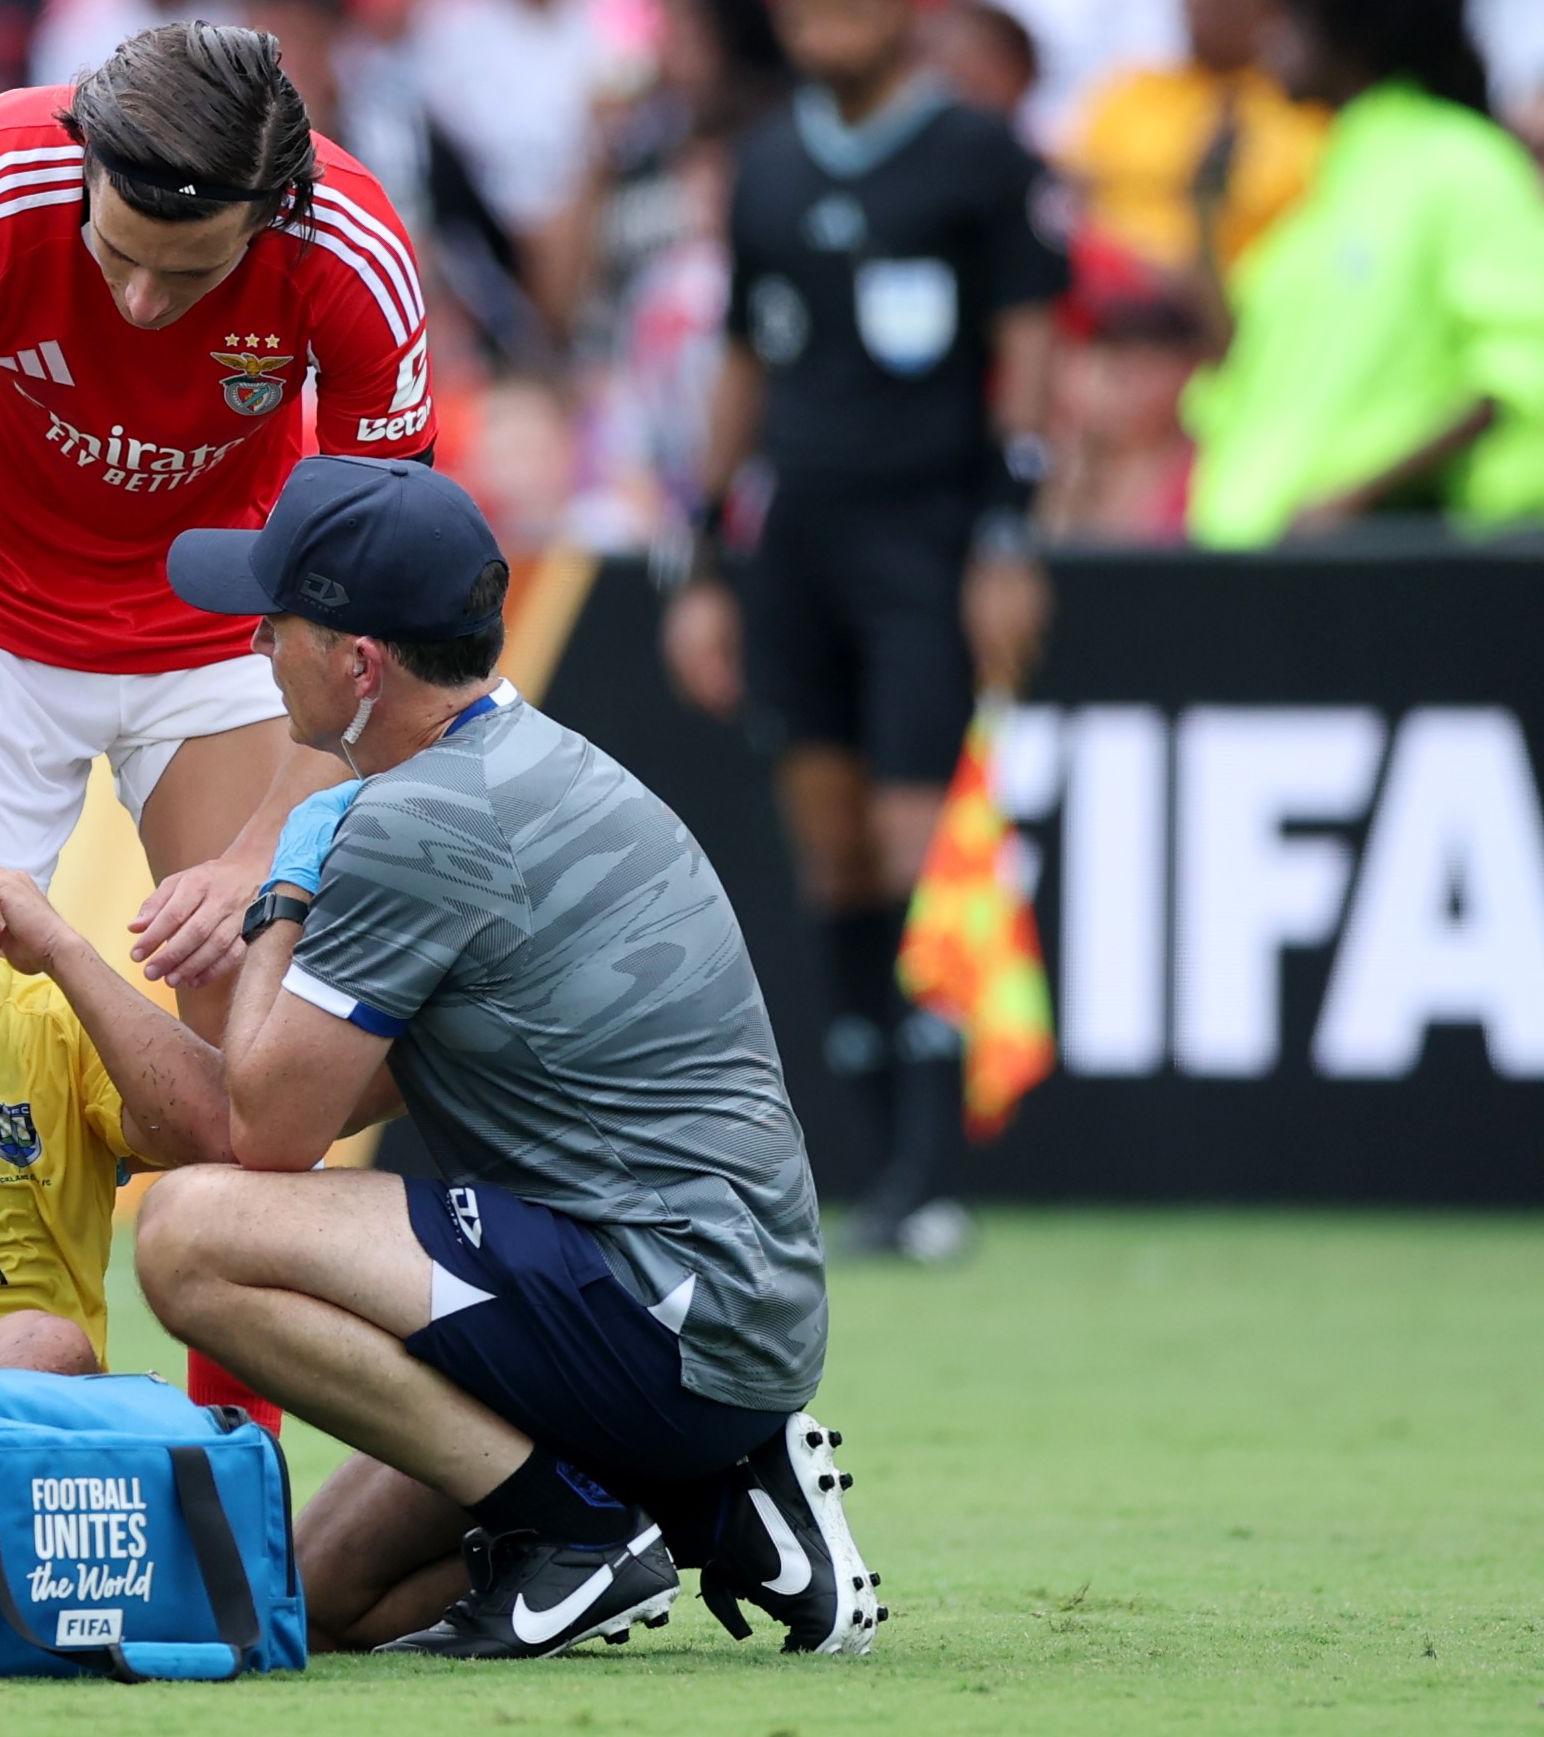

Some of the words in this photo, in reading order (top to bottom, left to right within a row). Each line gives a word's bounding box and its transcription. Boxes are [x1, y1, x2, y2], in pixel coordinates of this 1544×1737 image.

[45, 425, 96, 467] FLY
[998, 700, 1544, 1082] IFA
[31, 1477, 147, 1511] FOOTBALL
[33, 1512, 147, 1560] UNITES
[26, 1561, 74, 1602] the
[76, 1559, 154, 1603] World
[66, 1618, 112, 1637] FIFA
